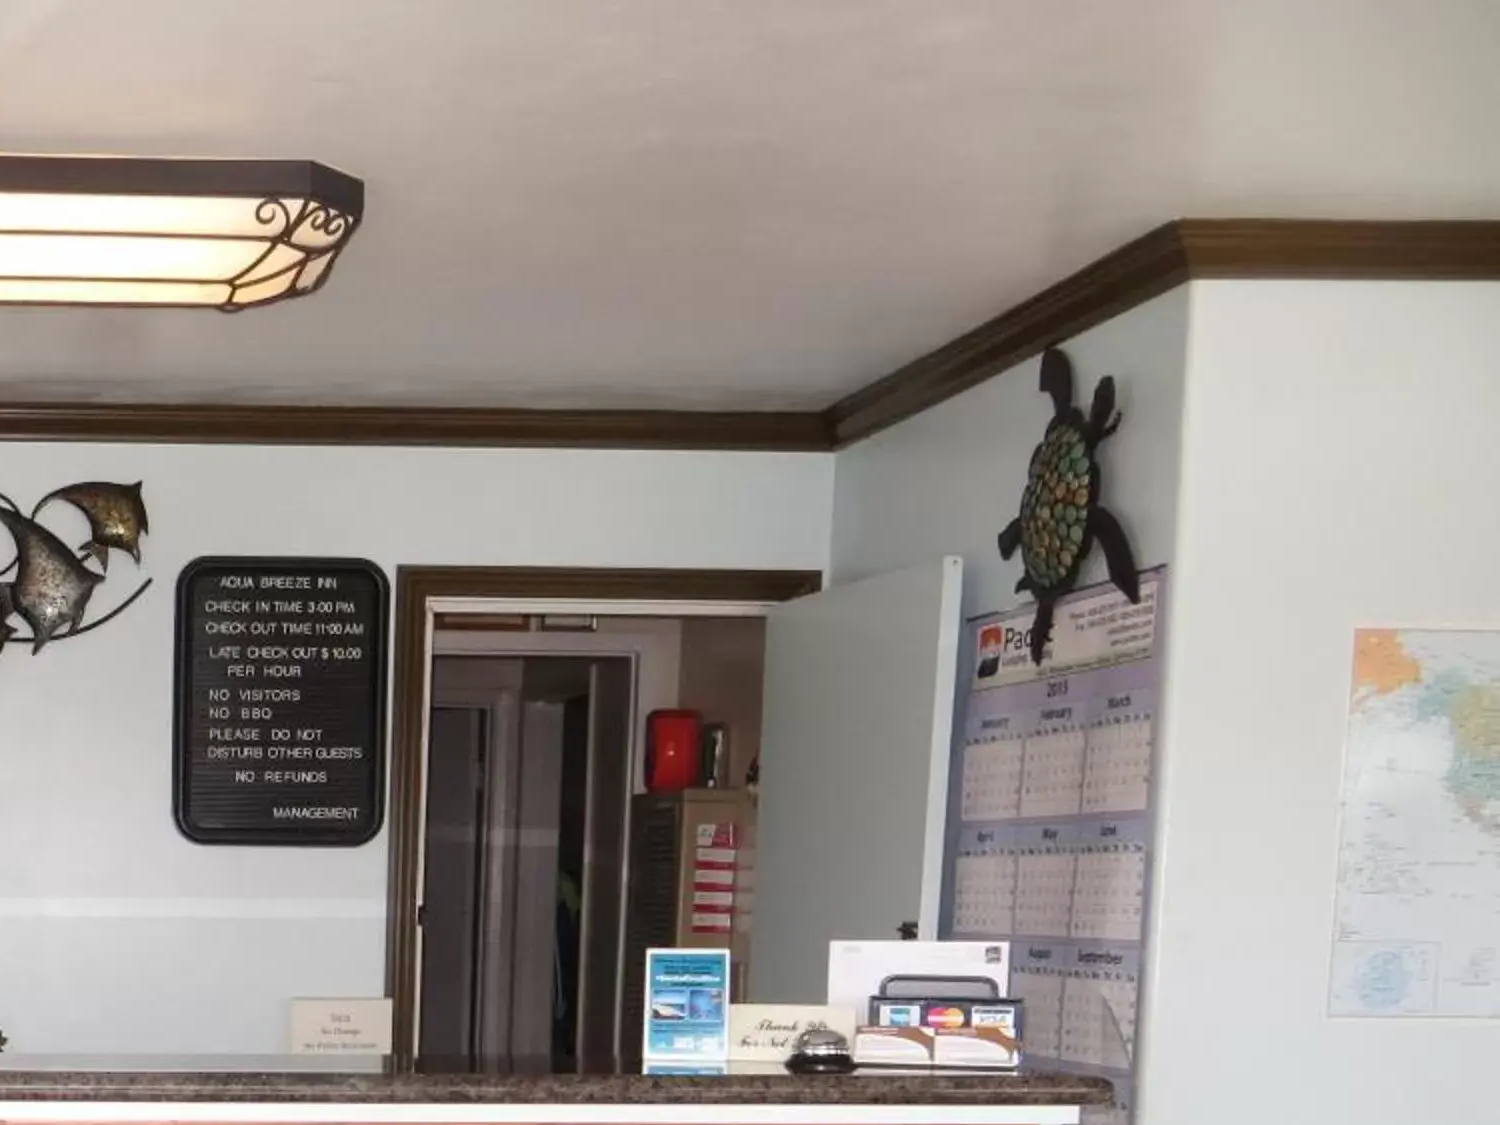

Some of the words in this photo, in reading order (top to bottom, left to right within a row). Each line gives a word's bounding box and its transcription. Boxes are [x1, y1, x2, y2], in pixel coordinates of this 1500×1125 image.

[220, 576, 255, 589] AQUA
[260, 576, 311, 589] BREEZE
[317, 576, 337, 589] INN
[205, 601, 250, 613] CHECK
[255, 601, 269, 613] IN
[274, 601, 303, 613] TIME
[335, 601, 355, 613] PM
[205, 622, 247, 635] CHECK
[251, 622, 277, 635] OUT
[282, 622, 312, 635] TIME
[343, 622, 364, 635] AM
[209, 646, 241, 659] LATE
[247, 646, 288, 660] CHECK
[291, 647, 319, 660] OUT
[227, 665, 255, 677] PER
[263, 665, 302, 677] HOUR
[209, 689, 230, 701] NO
[239, 689, 301, 701] VISITORS
[209, 707, 230, 719] NO
[209, 728, 260, 741] PLEASE
[271, 729, 291, 741] DO
[297, 729, 323, 741] NOT
[207, 747, 263, 759] DISTURB
[267, 747, 313, 759] OTHER
[316, 747, 363, 760] GUESTS
[235, 771, 255, 783] NO
[264, 771, 327, 783] REFUNDS
[273, 807, 359, 819] MANAGEMENT
[755, 1019, 798, 1031] Thank
